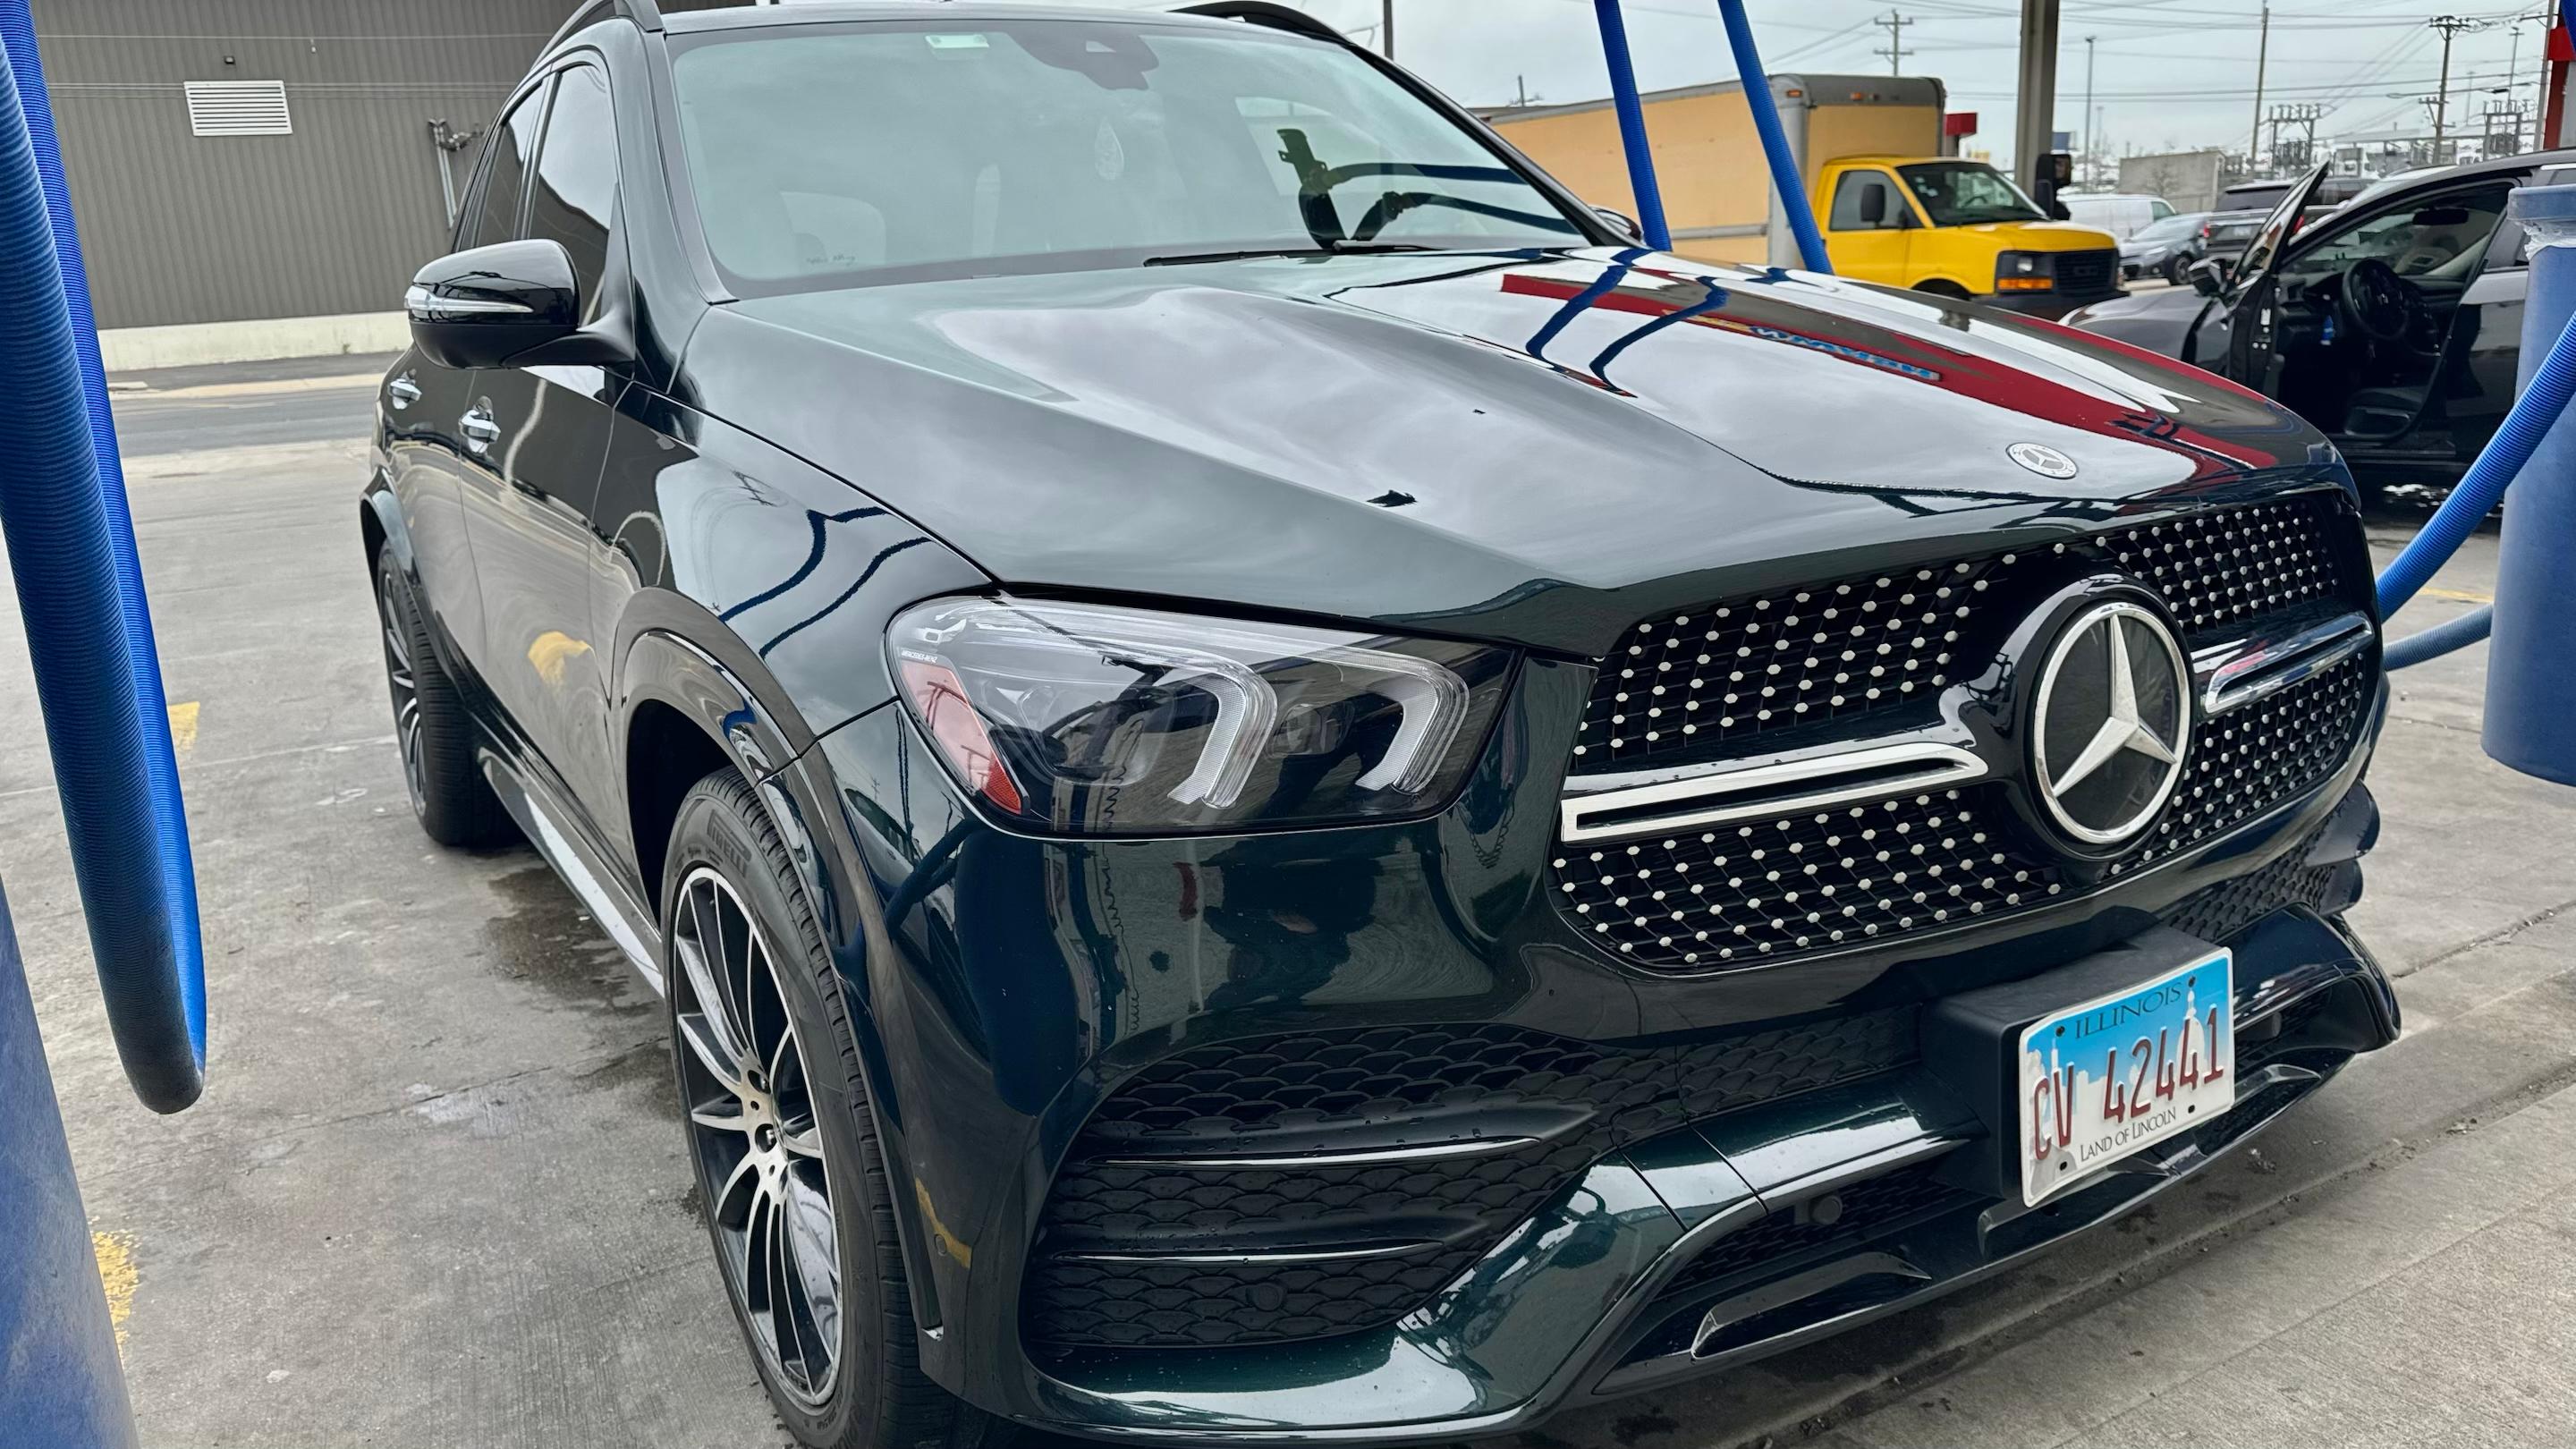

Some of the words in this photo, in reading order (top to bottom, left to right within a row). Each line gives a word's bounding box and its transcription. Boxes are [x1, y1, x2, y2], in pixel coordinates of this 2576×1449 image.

[707, 809, 751, 877] PIRELLI
[2076, 982, 2182, 1038] ILLINOIS
[2034, 1063, 2075, 1160] CV
[2103, 1006, 2224, 1123] 42441
[2080, 1136, 2113, 1162] LAND
[2114, 1128, 2129, 1146] OF
[2131, 1106, 2176, 1140] LINCOLN
